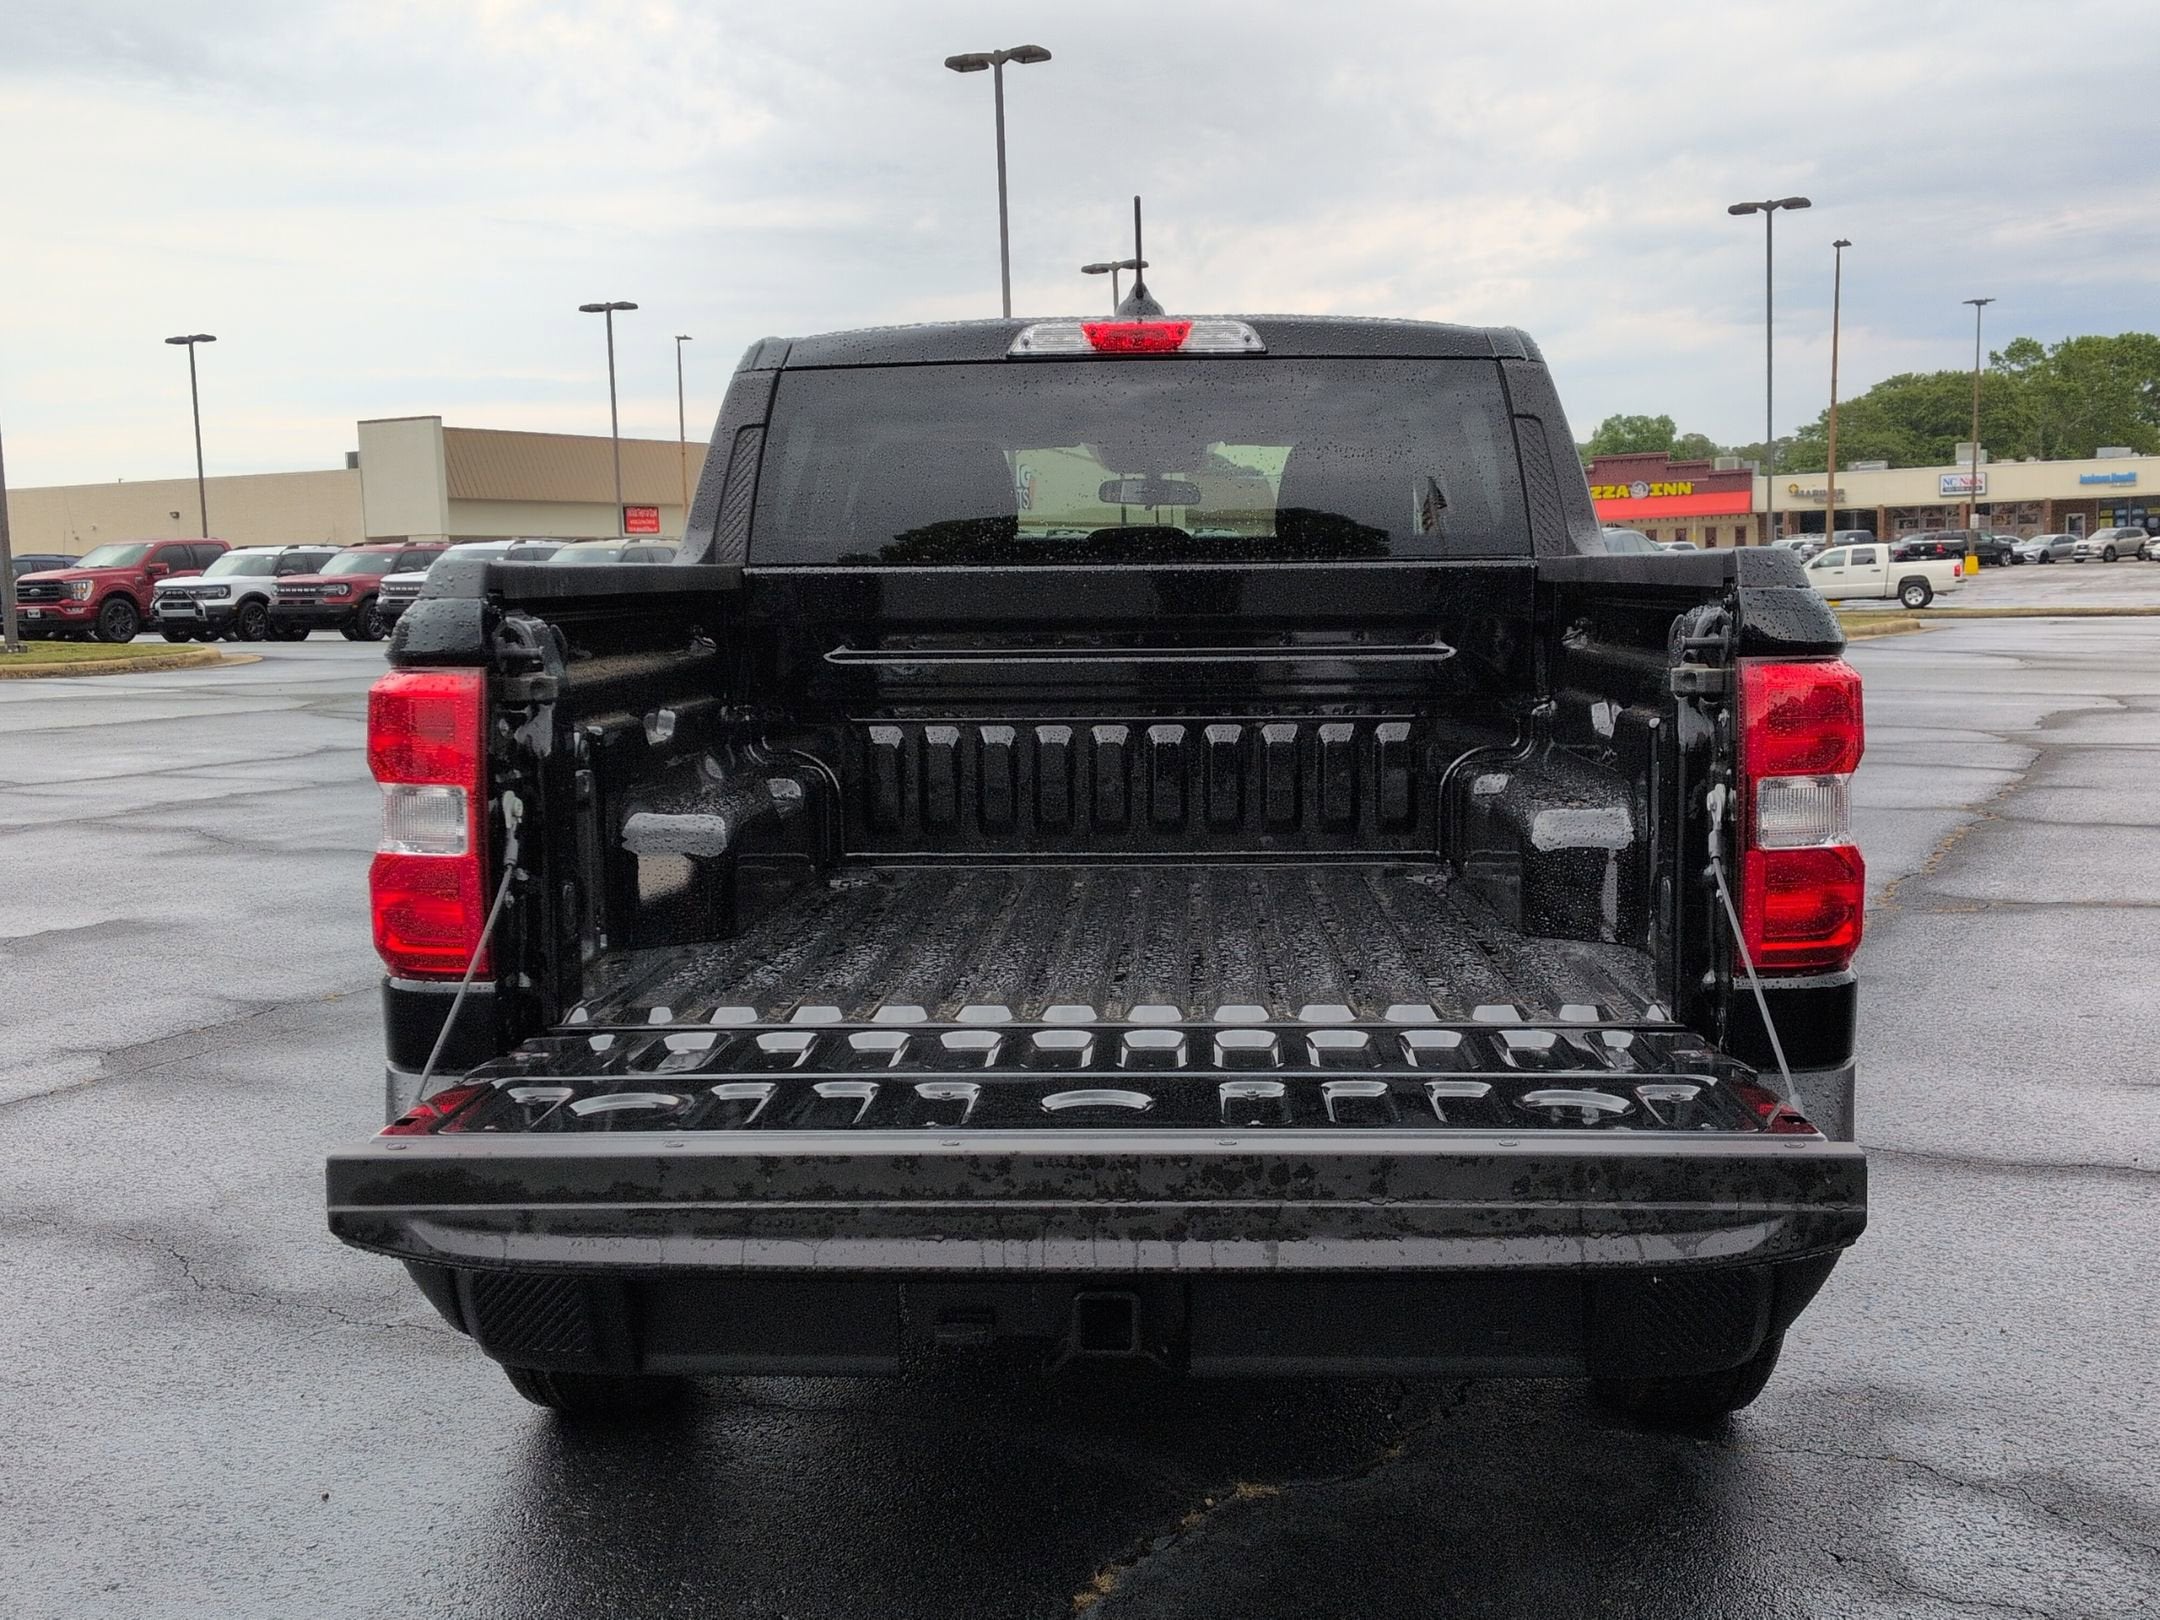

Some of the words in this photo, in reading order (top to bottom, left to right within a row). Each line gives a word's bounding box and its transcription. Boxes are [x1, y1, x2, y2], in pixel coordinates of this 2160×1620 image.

[1016, 464, 1032, 488] IG
[1960, 476, 1984, 487] Nas
[1590, 485, 1631, 499] ZZA
[1650, 482, 1694, 497] INN
